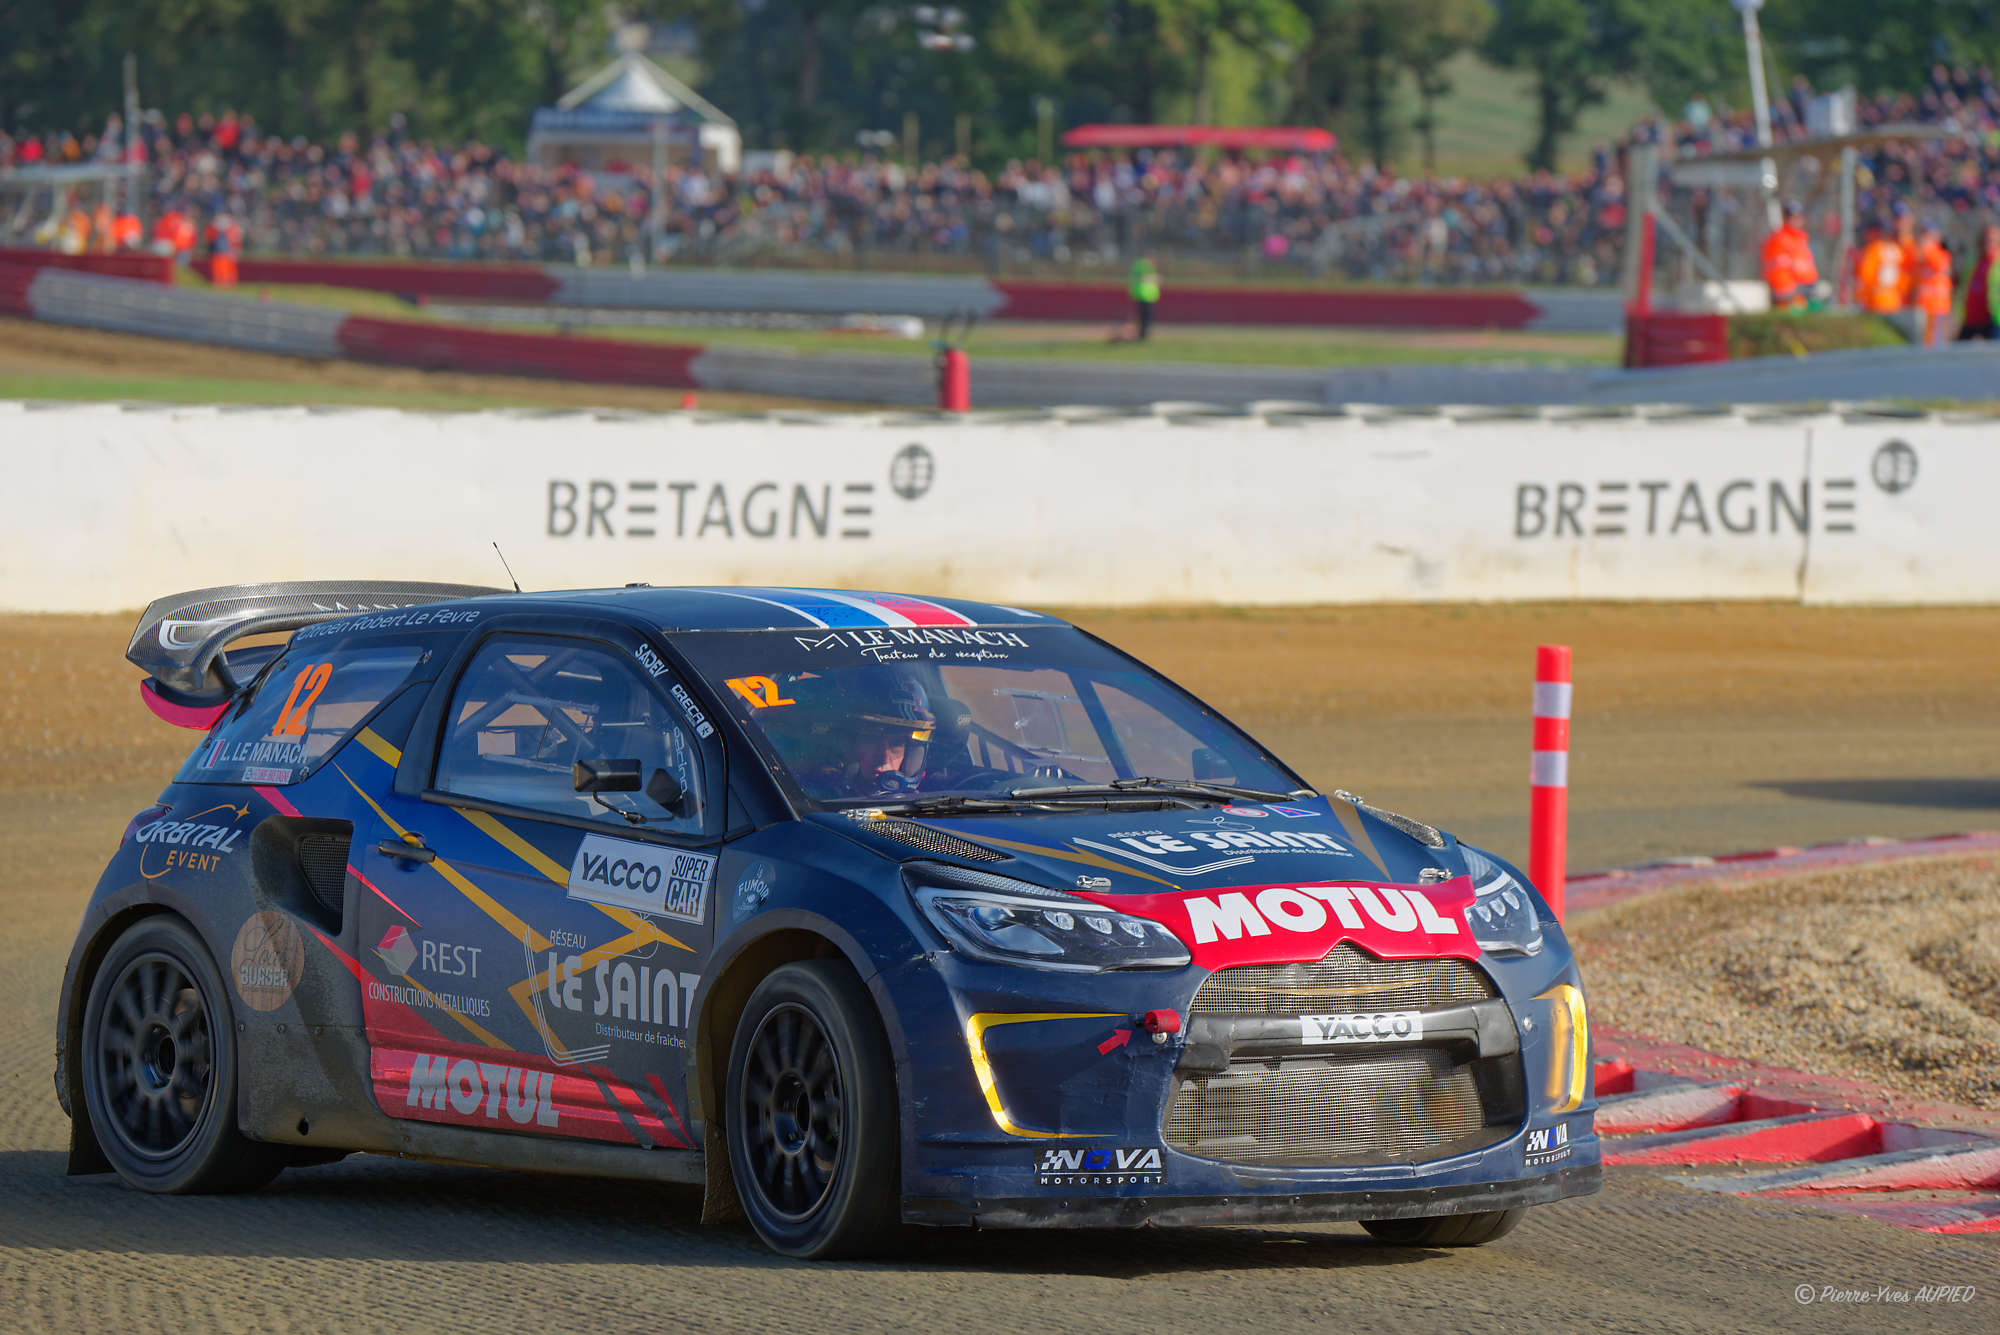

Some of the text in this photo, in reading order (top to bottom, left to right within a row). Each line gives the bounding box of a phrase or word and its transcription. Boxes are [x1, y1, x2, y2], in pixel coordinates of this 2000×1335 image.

[546, 479, 875, 538] BRETAGNE
[1513, 479, 1857, 538] BRETAGNE
[350, 613, 405, 631] Robert
[405, 610, 425, 626] Le
[847, 628, 1030, 648] LE MANACH
[634, 643, 670, 678] SADEV
[928, 647, 947, 659] de
[271, 663, 333, 736] 12
[671, 684, 705, 725] ORECA
[725, 675, 796, 709] 12
[231, 741, 253, 761] LE
[248, 742, 312, 764] MANACH
[135, 821, 243, 854] ORBITAL
[1119, 831, 1349, 854] LE SAINT
[166, 849, 222, 873] EVENT
[581, 851, 662, 894] YACCO
[671, 854, 709, 882] SUPER
[666, 880, 701, 918] CAR
[1183, 886, 1460, 944] MOTUL
[549, 928, 587, 950] RÉSEAU
[421, 939, 482, 979] REST
[239, 966, 290, 988] BURGER
[548, 951, 702, 1029] LE SAINT
[368, 981, 434, 1009] CONSTRUCTIONS
[595, 1022, 643, 1041] Distributeur
[644, 1030, 656, 1044] de
[1312, 1013, 1413, 1041] YACCO
[406, 1053, 560, 1128] MOTUL
[1525, 1149, 1572, 1167] MOTORSPORT
[1040, 1176, 1162, 1185] MOTORSPORT
